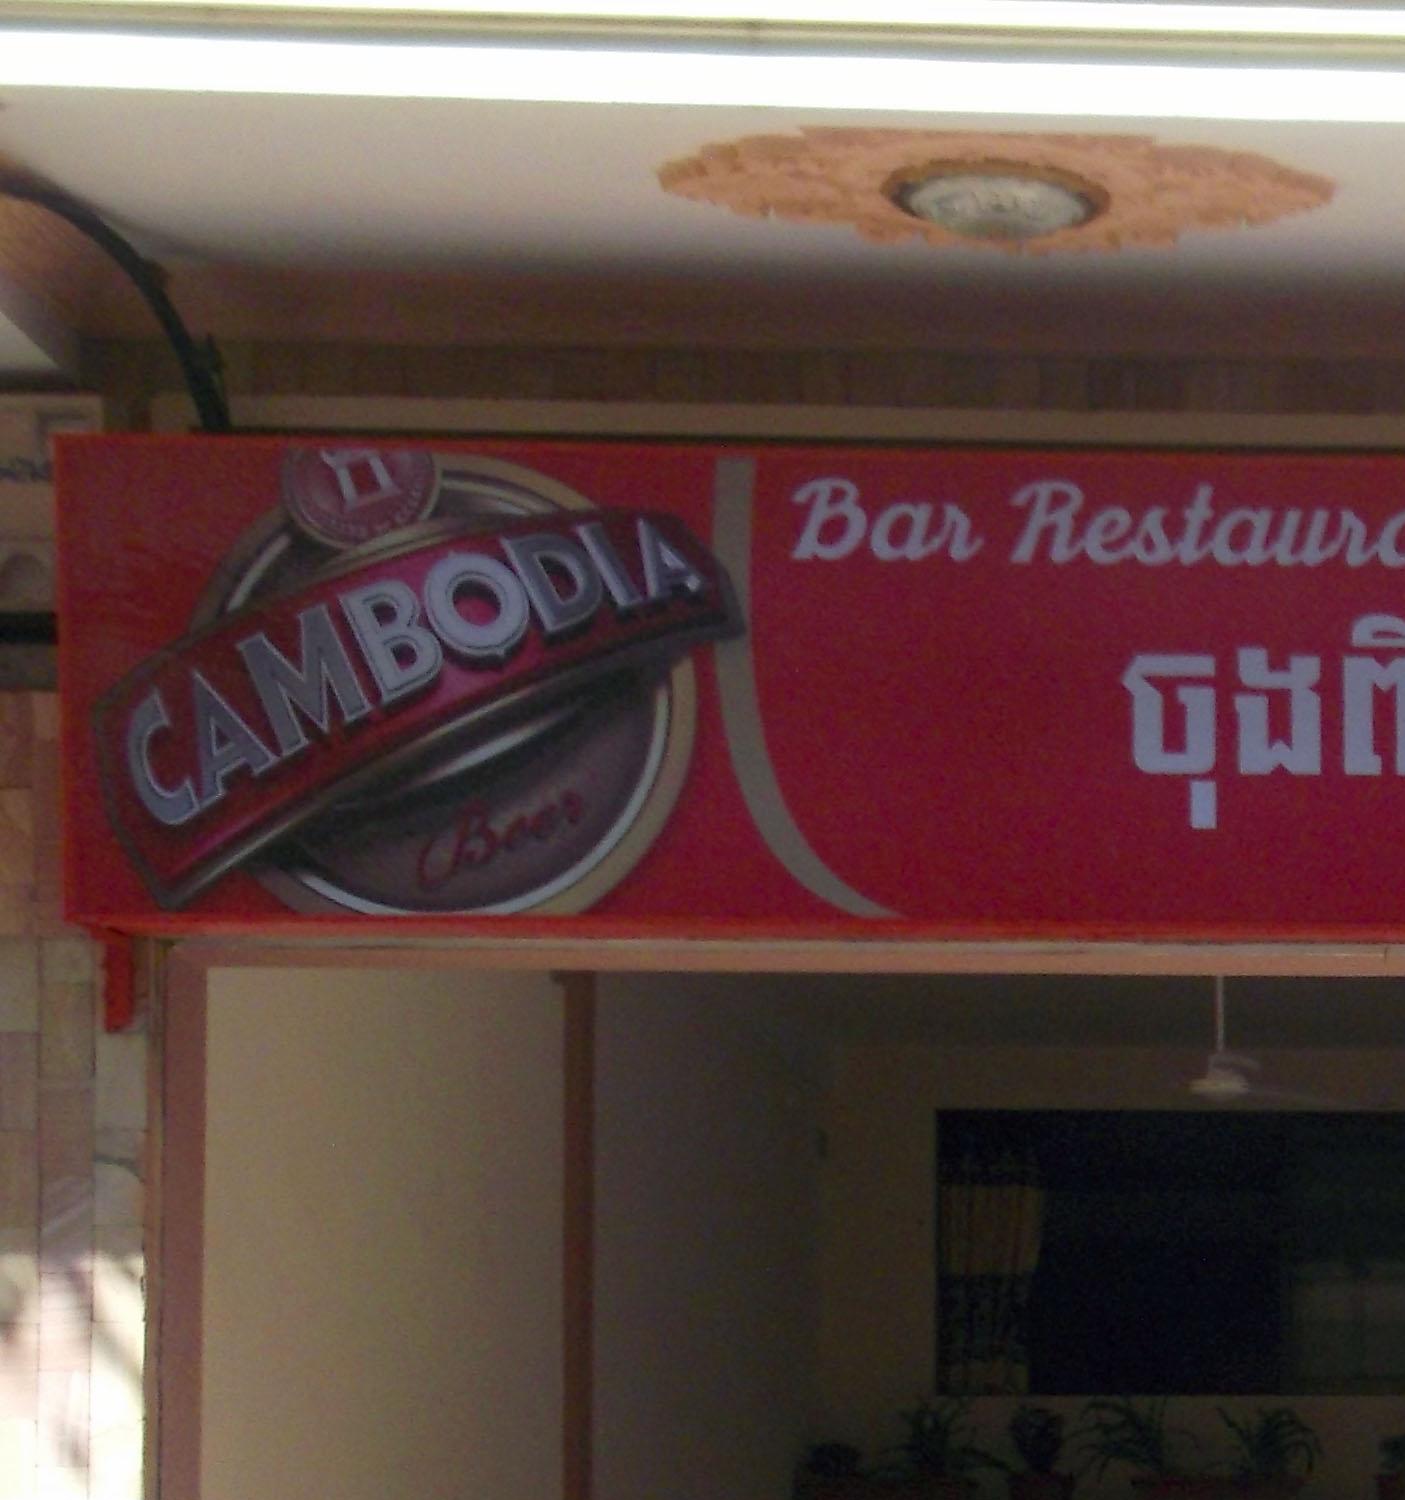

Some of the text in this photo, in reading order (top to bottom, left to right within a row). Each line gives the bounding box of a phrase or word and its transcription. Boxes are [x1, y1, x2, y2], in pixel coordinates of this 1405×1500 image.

[793, 477, 982, 562] Bar
[127, 518, 704, 828] CAMBODIA
[416, 790, 587, 885] Beer
